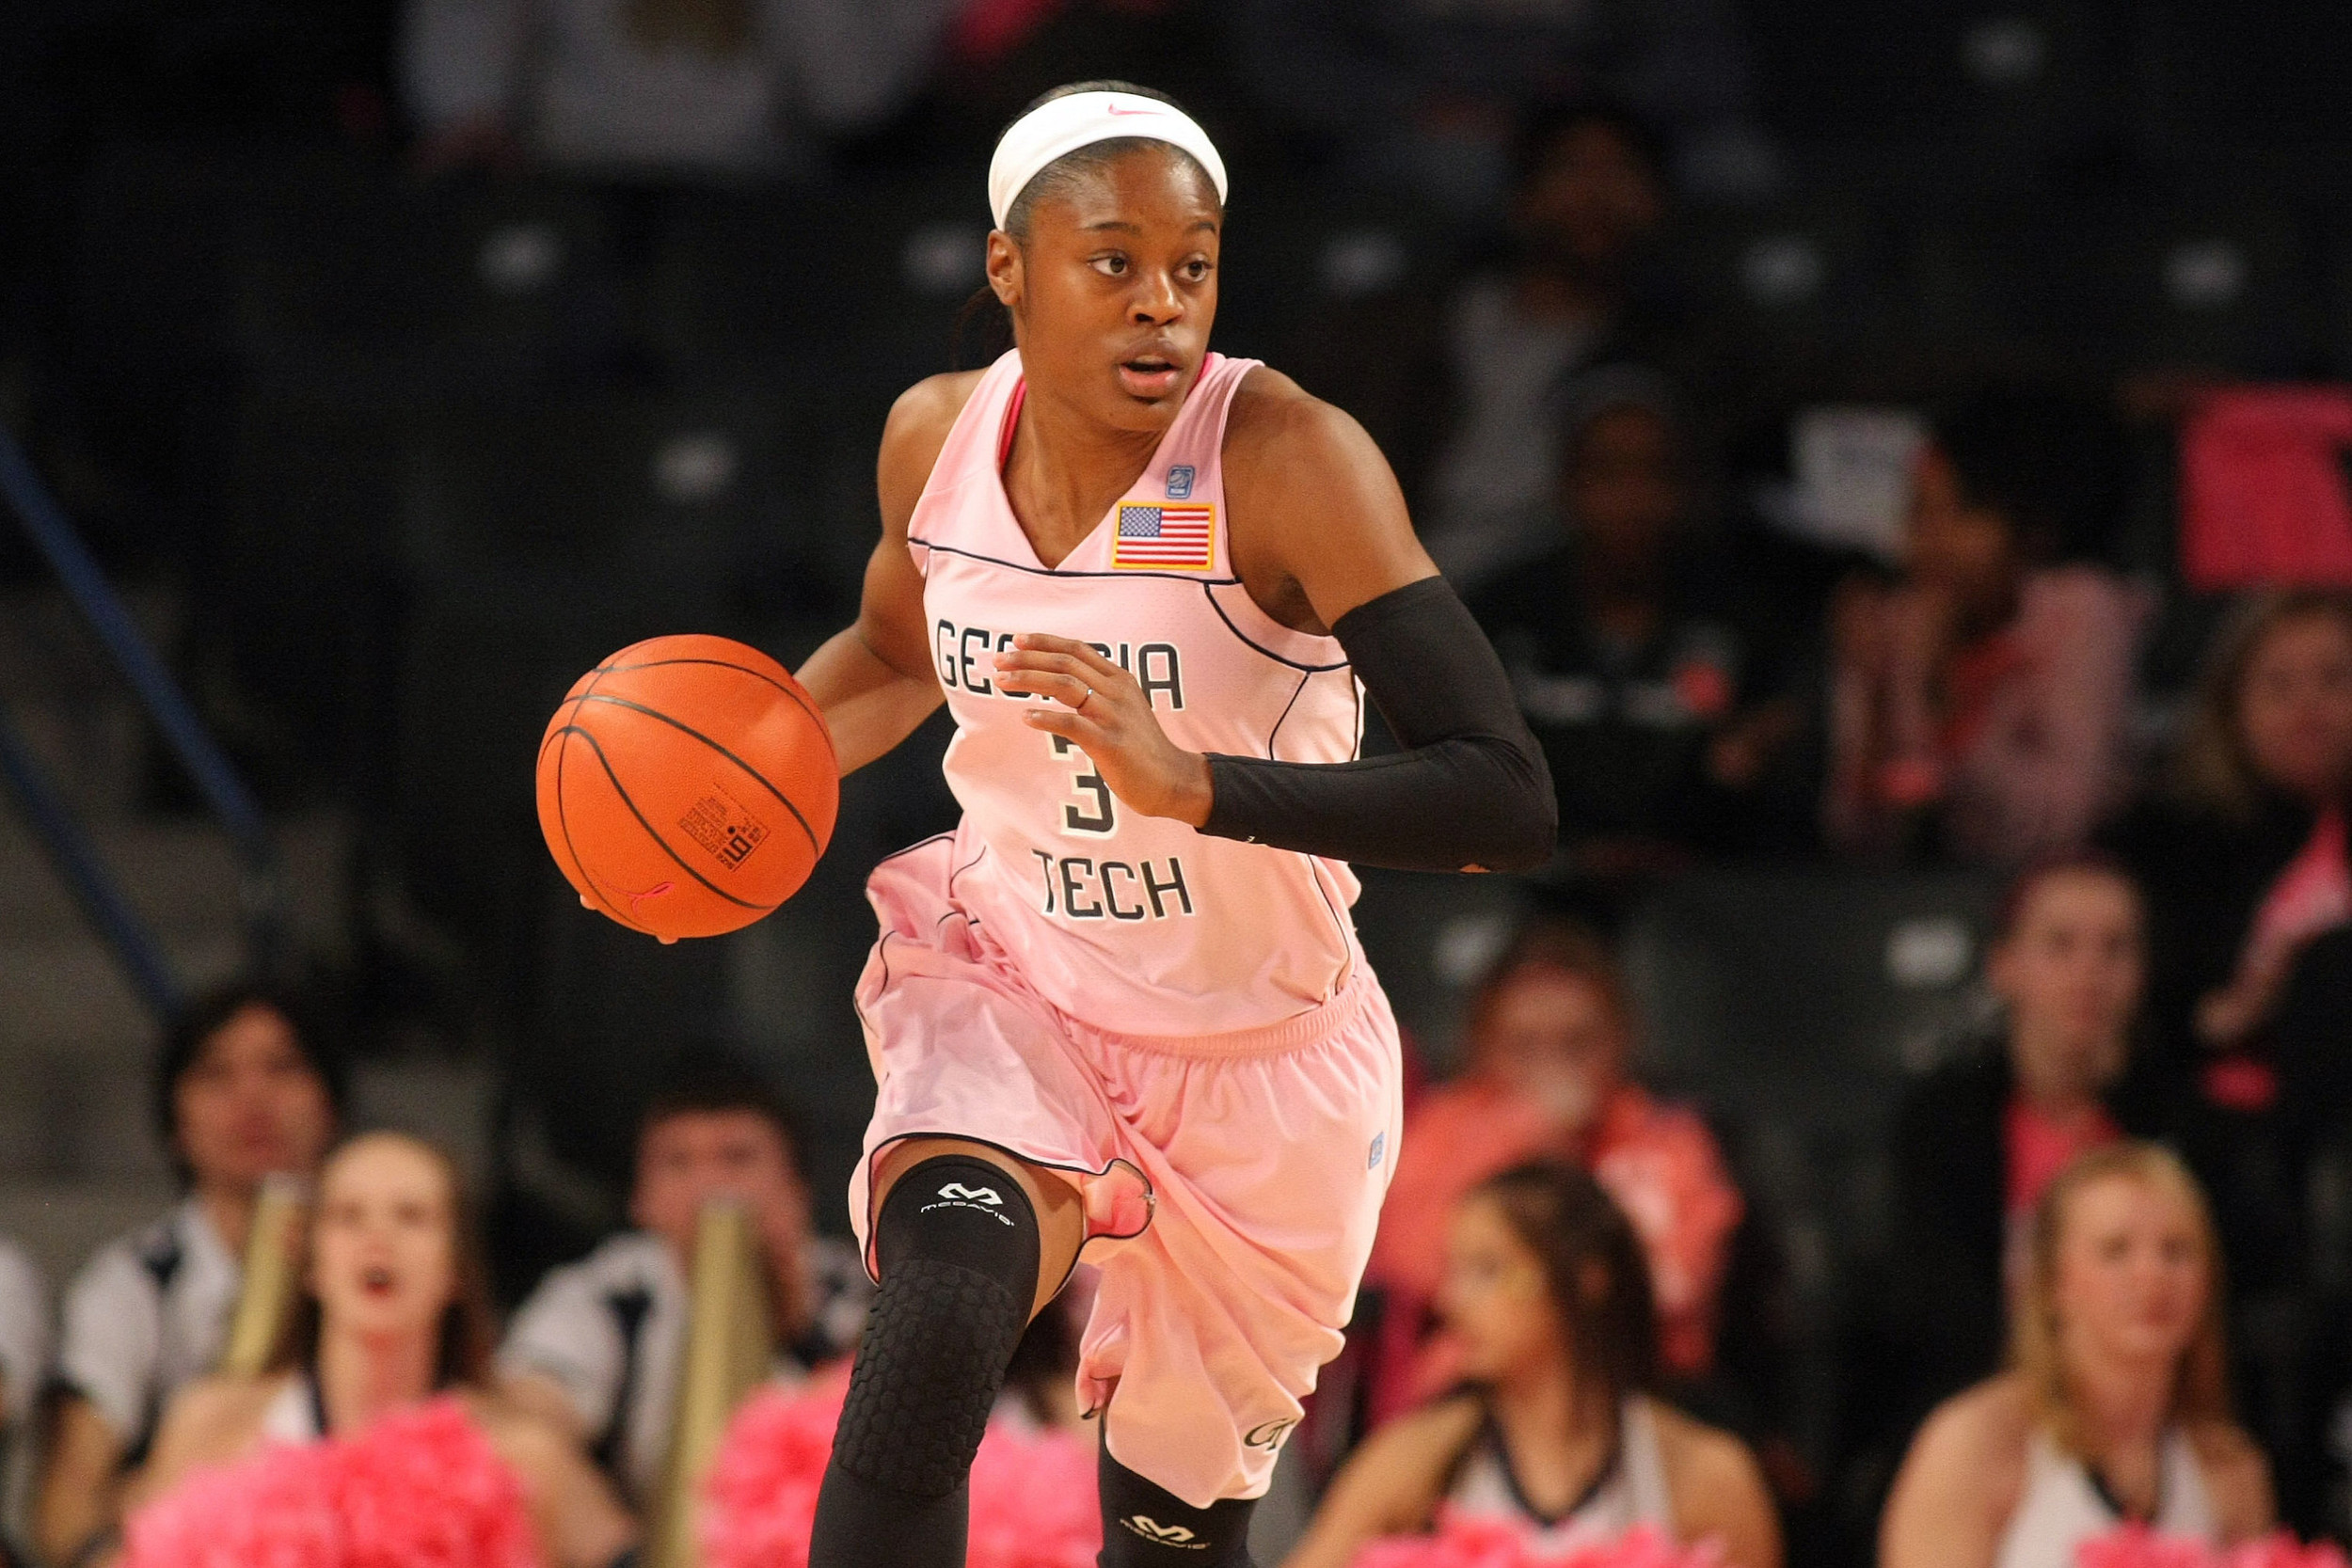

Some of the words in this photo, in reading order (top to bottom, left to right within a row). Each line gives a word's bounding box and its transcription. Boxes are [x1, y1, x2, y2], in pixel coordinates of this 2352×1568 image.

[936, 618, 1184, 710] GEIA
[1051, 733, 1115, 833] 3
[1031, 847, 1193, 921] TECH
